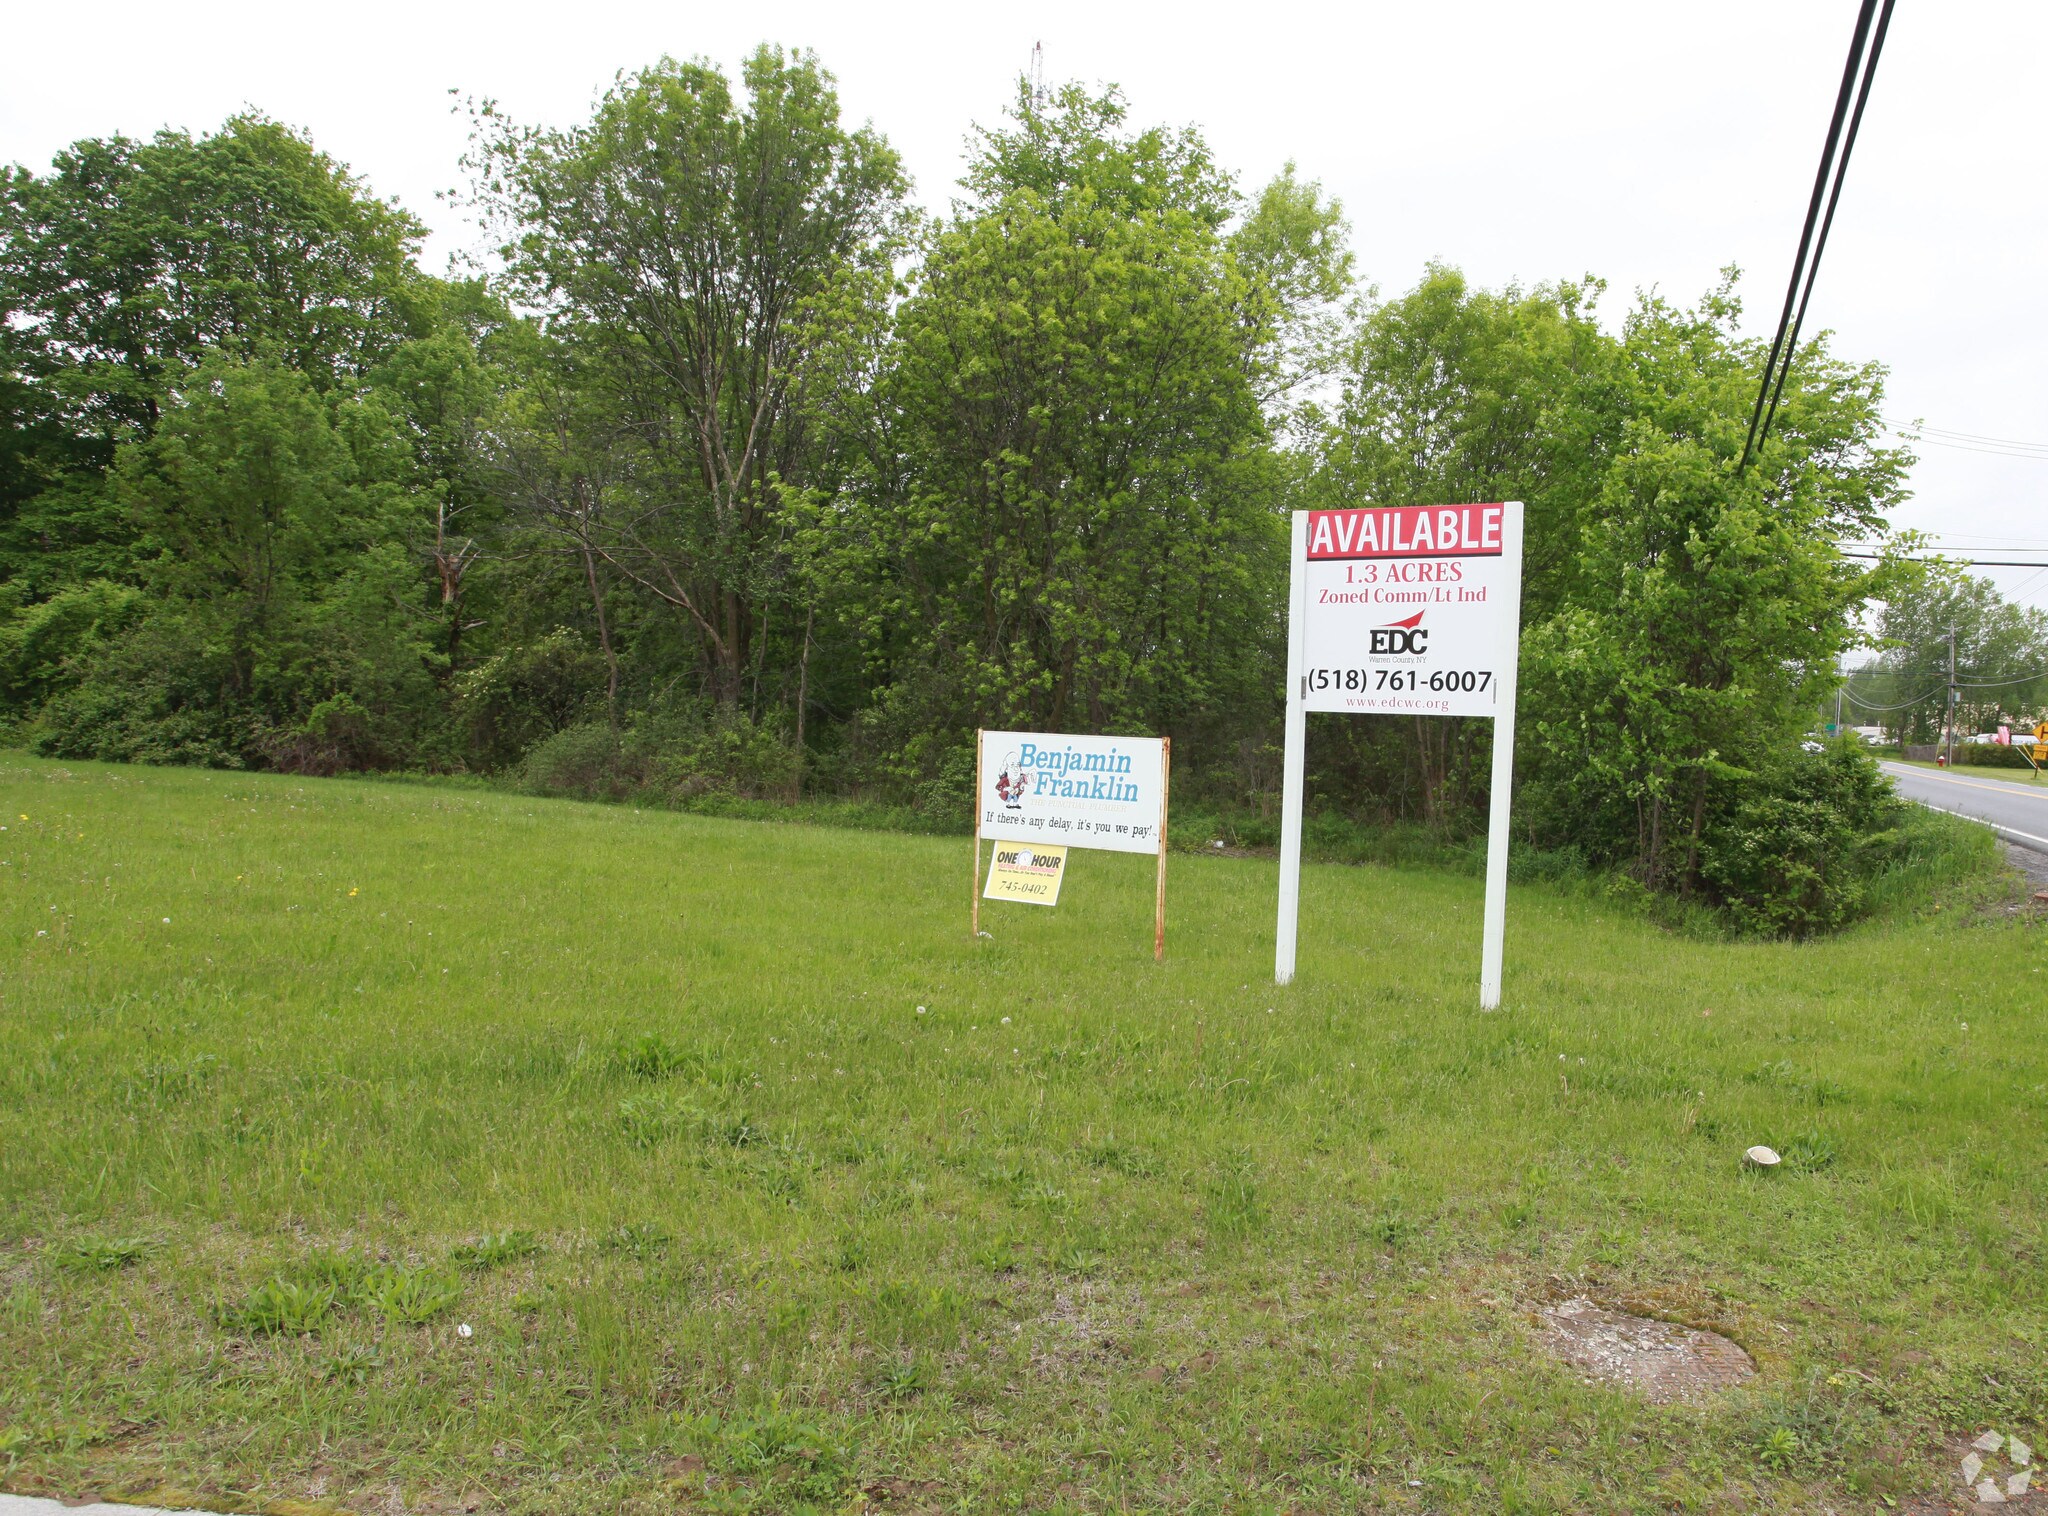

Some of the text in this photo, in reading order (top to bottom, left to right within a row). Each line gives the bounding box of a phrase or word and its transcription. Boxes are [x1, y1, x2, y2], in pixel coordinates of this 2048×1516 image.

[1311, 508, 1501, 554] AVAILABLE
[1345, 562, 1462, 584] 1.3 ACRES
[1319, 586, 1487, 604] Zoned Comm/Lt Ind
[1369, 629, 1428, 655] EDC
[1308, 668, 1492, 694] (518) 761-6007
[1346, 697, 1450, 712] www.edcwc.org
[1021, 744, 1132, 778] Benjamin
[1034, 772, 1138, 802] Franklin
[986, 811, 994, 822] If
[998, 812, 1026, 825] there's
[1029, 817, 1045, 830] any
[1077, 819, 1091, 830] it's
[1094, 823, 1111, 835] you
[1116, 824, 1128, 834] we
[1132, 825, 1152, 839] pay!
[997, 851, 1061, 868] ONE HOUR
[999, 880, 1048, 894] 745-0402
